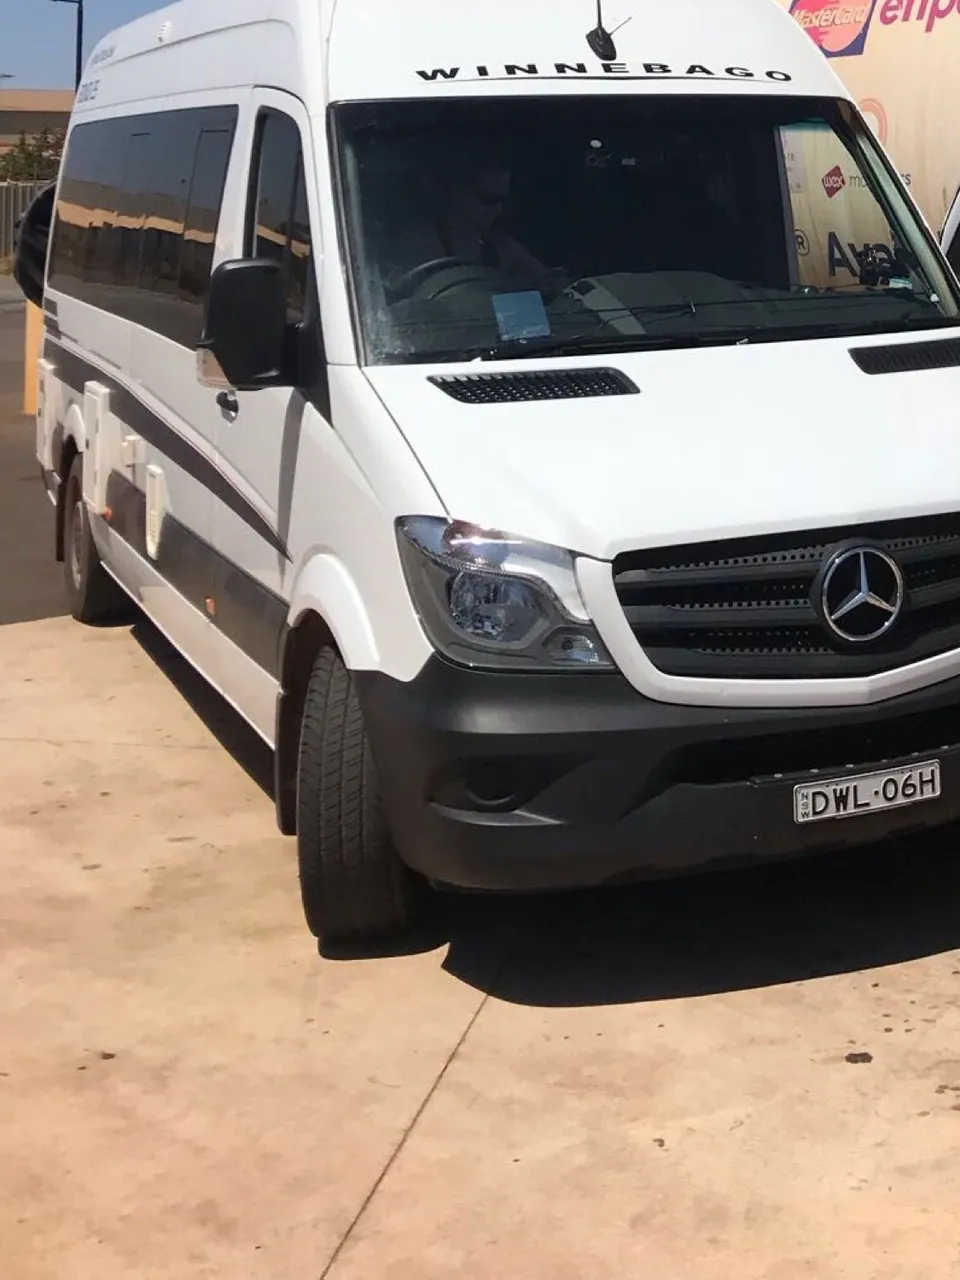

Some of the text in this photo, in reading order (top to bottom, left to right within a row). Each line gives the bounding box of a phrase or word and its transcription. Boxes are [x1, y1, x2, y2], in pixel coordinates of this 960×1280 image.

[415, 62, 793, 82] WINNEBAGO
[824, 175, 845, 188] wex
[800, 792, 810, 818] NSW
